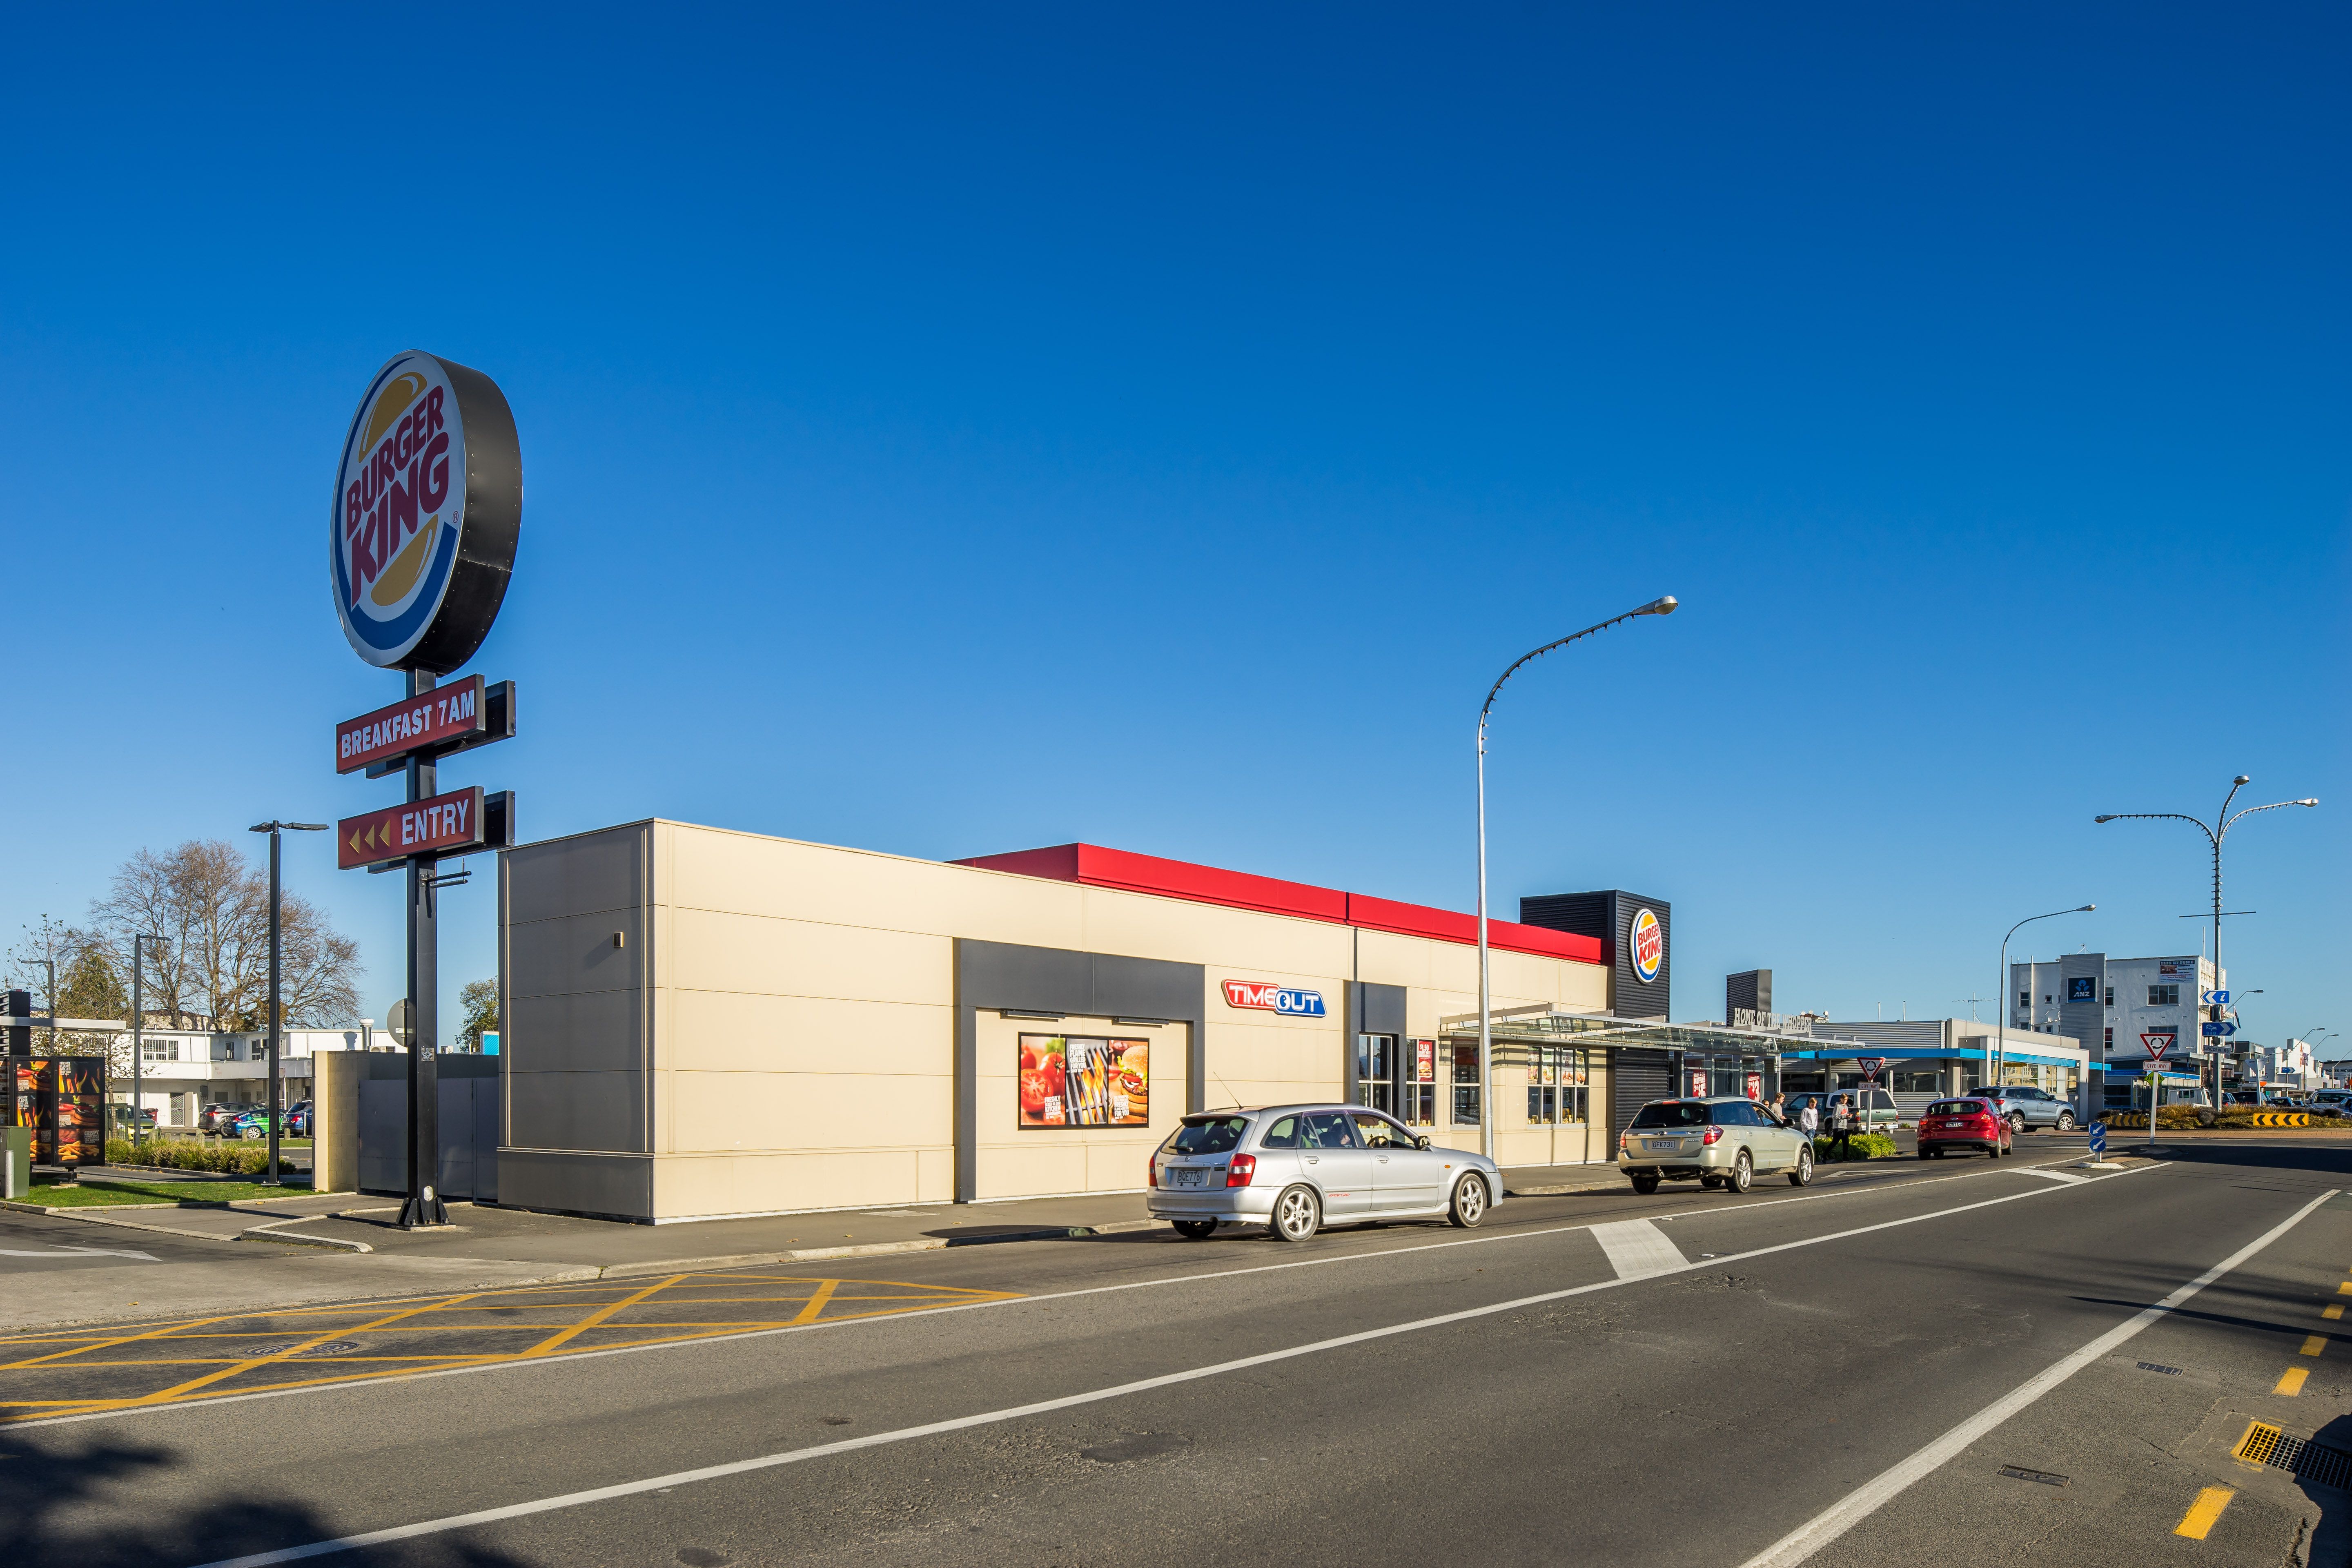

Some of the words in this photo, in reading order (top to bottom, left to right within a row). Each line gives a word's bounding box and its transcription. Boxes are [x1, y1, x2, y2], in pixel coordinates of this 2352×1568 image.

[346, 385, 444, 542] BURGER
[351, 432, 449, 612] KING
[341, 704, 432, 759] BREAKFAST
[439, 690, 474, 726] 7AM
[402, 799, 468, 845] ENTRY
[1638, 924, 1660, 947] BURGER
[1638, 936, 1661, 965] KING
[1275, 991, 1319, 1012] OUT
[1733, 1007, 1756, 1027] HOME
[1757, 1011, 1766, 1027] OF
[1767, 1012, 1780, 1029] THE
[1782, 1013, 1812, 1031] WHOPPER
[1420, 1043, 1429, 1052] $1.50
[1178, 1172, 1200, 1181] BQE776
